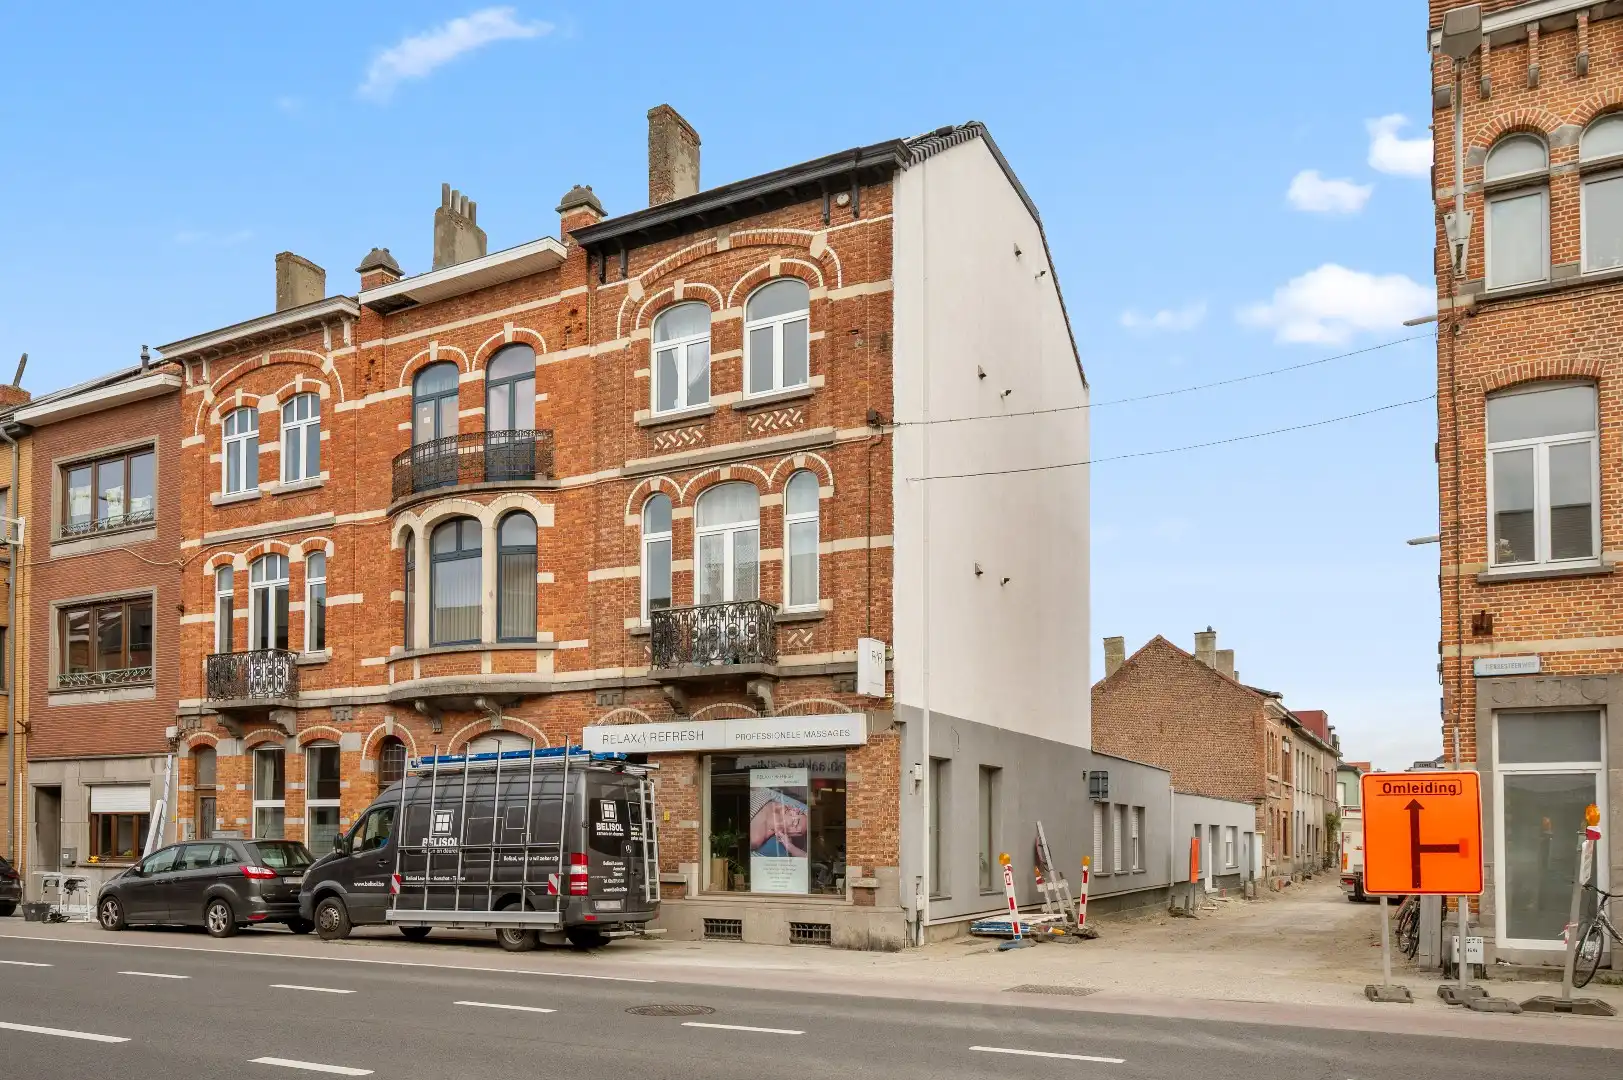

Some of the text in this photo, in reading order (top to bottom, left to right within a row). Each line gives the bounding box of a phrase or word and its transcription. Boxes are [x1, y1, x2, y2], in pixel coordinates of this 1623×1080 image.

[602, 733, 637, 745] RELAX
[649, 730, 705, 743] REFRESH
[735, 729, 851, 741] PROFESSIONELE MASSAGES
[1382, 782, 1457, 796] Omleiding
[596, 822, 624, 831] BELISOL
